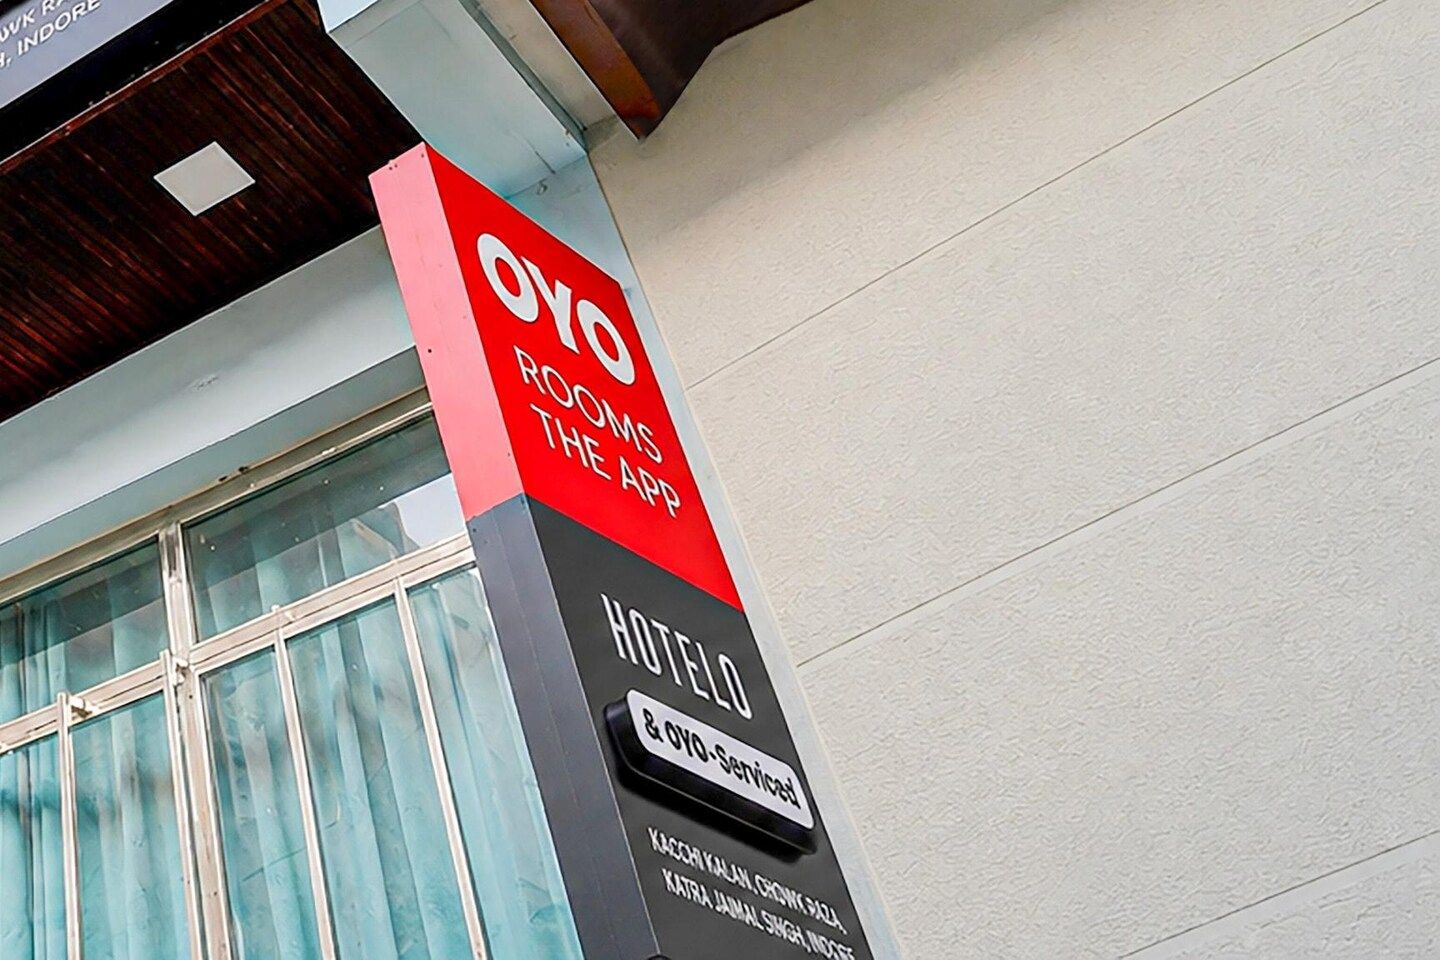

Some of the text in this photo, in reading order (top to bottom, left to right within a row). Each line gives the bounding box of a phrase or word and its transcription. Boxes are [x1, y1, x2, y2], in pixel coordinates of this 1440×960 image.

[477, 232, 636, 386] OYO
[513, 344, 662, 464] ROOMS
[529, 402, 681, 518] THE APP
[642, 708, 664, 742] &
[661, 867, 714, 909] KATRA
